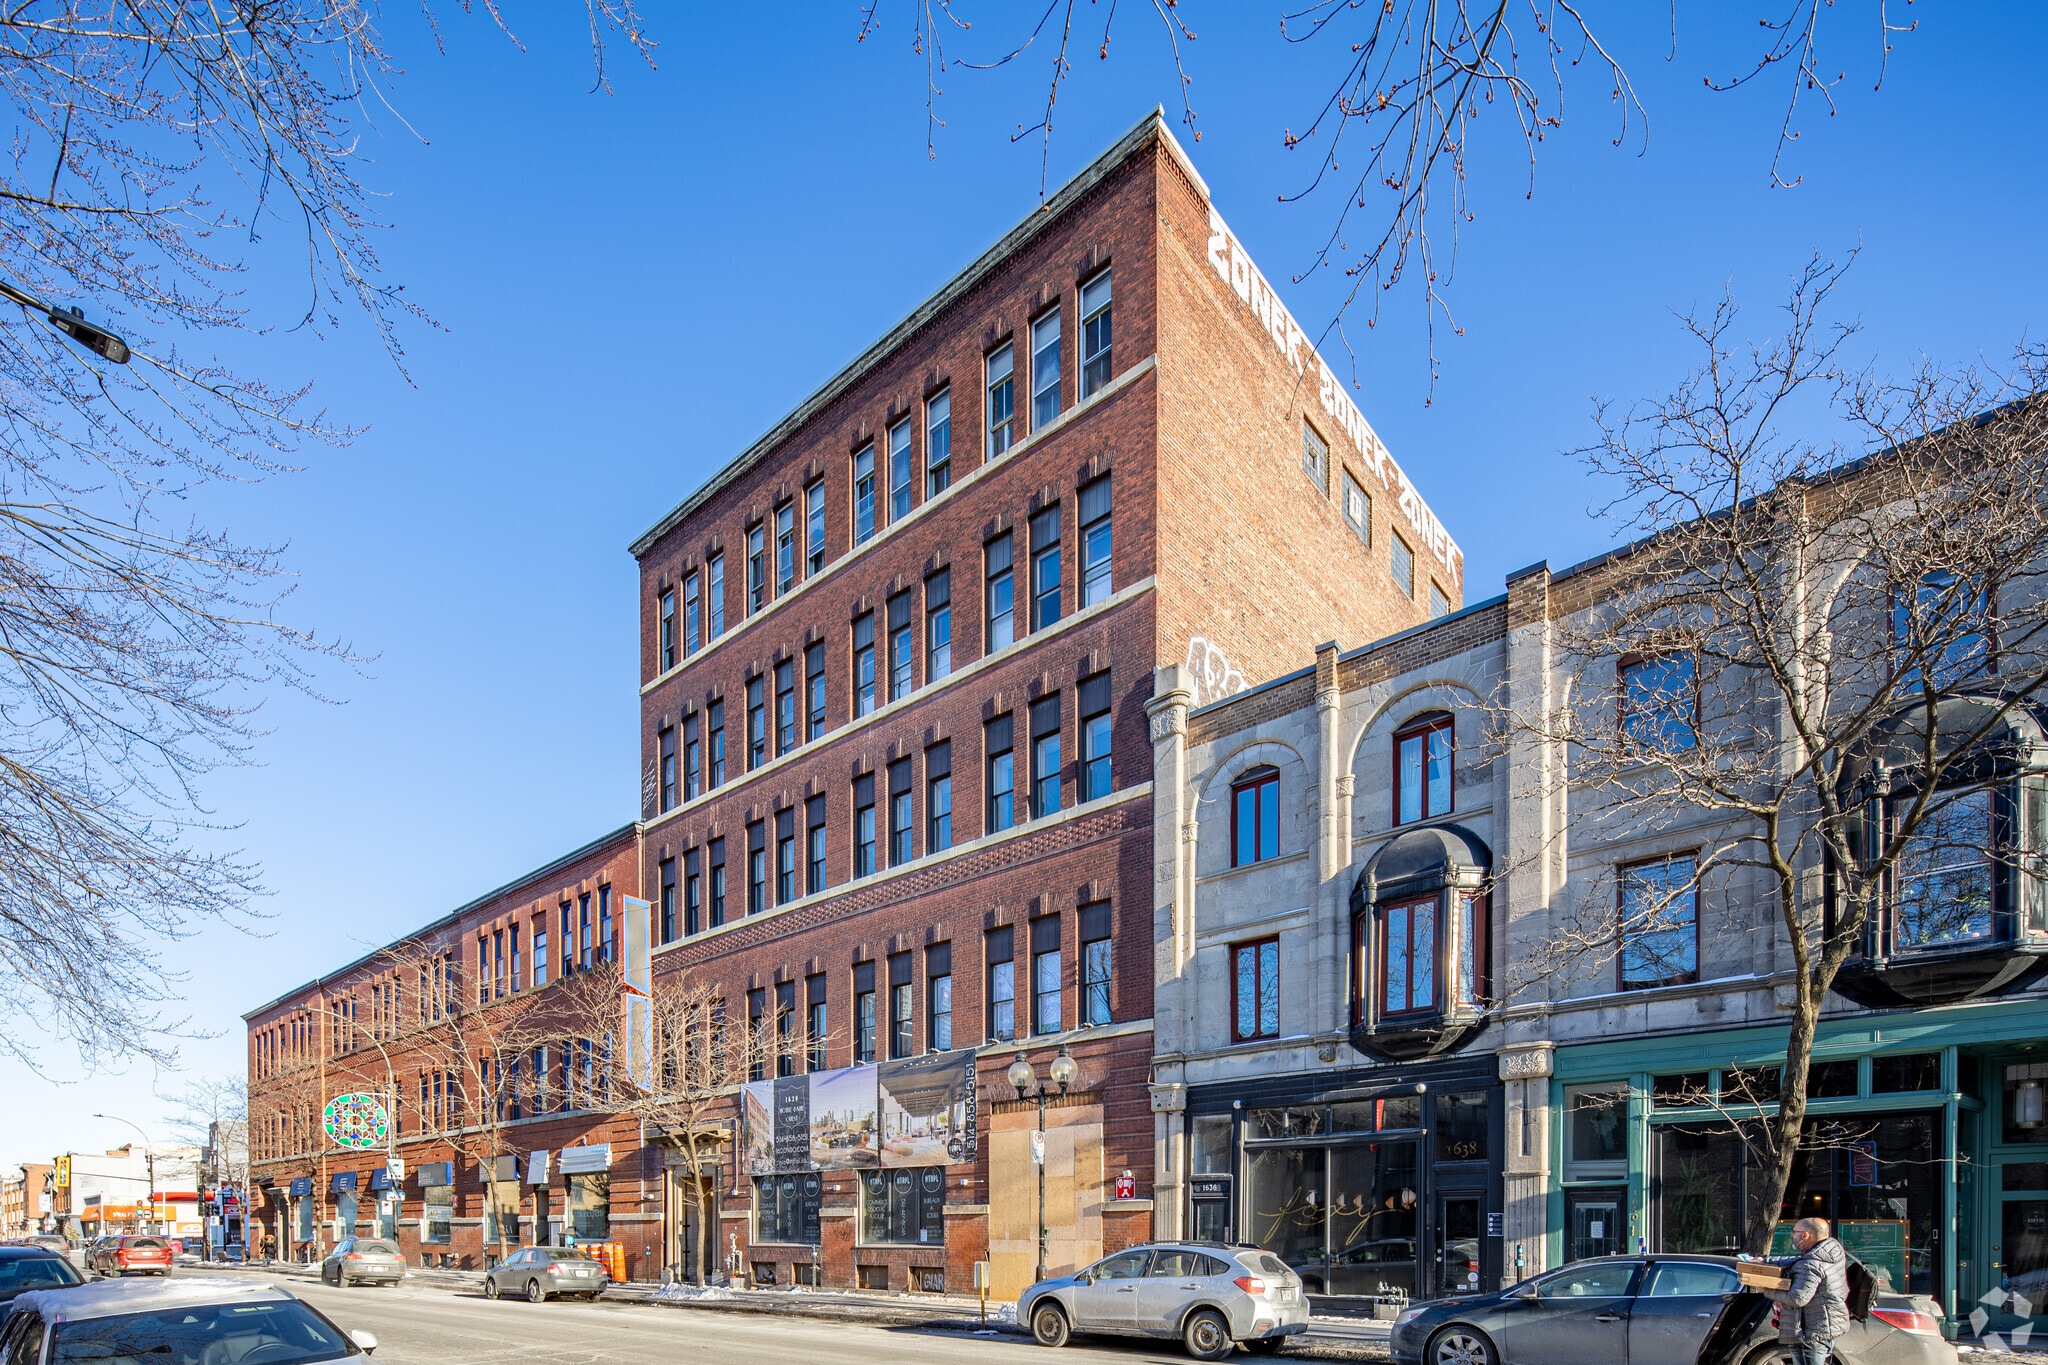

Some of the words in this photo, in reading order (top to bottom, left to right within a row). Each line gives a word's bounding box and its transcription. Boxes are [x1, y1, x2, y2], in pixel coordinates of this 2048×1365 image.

[966, 1063, 976, 1149] 514-858-5151
[1446, 1141, 1478, 1158] 1638
[1257, 1186, 1405, 1246] foxy
